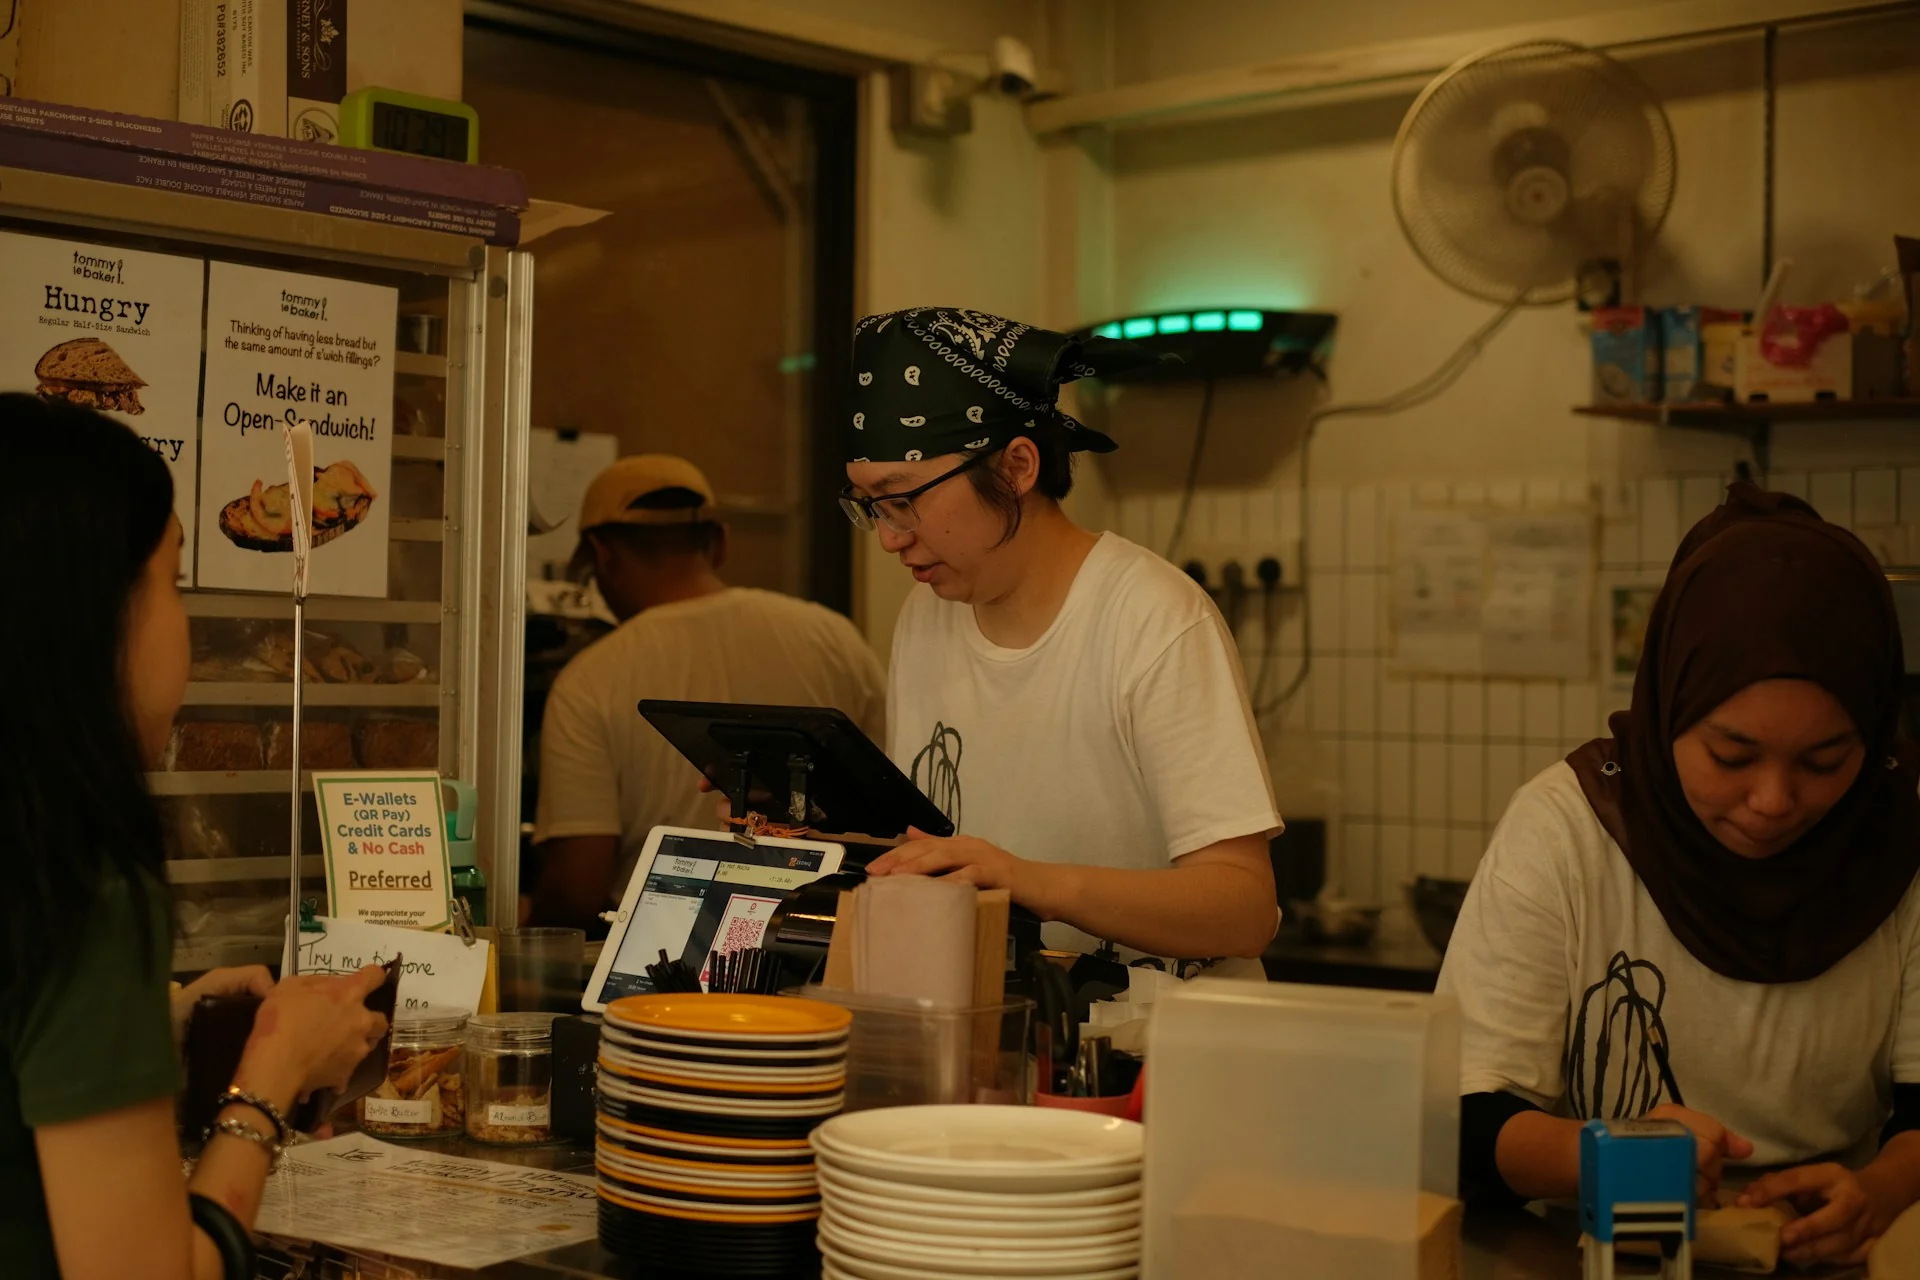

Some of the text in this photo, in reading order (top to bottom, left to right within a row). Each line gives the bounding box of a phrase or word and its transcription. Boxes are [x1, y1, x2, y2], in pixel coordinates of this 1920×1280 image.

[301, 32, 311, 42] &
[301, 46, 311, 79] SONS
[15, 116, 45, 126] SHEETS
[39, 109, 87, 123] PARCHMENT
[88, 117, 113, 127] 2-SIDE
[115, 121, 162, 134] SILICONIZED
[138, 155, 165, 166] FRANCE
[136, 175, 153, 185] FACE
[155, 178, 182, 189] DOUBLE
[256, 173, 274, 182] AVEC
[283, 198, 305, 208] PAPIER
[329, 204, 370, 218] SILICONIZED
[428, 211, 451, 220] SHEETS
[392, 215, 431, 227] PARCHMENT
[432, 221, 467, 233] VEGETABLE
[73, 251, 115, 272] tommy
[44, 285, 150, 325] Hungry
[281, 289, 320, 308] tommy
[39, 316, 151, 336] Regular Half-Size Sandwich
[230, 320, 376, 350] Thinking of having less bread but
[225, 336, 380, 370] the same amount of s'wich fillings?
[257, 373, 347, 406] Make it an
[343, 792, 417, 805] E-Wallets
[354, 809, 410, 822] (QR Pay)
[337, 824, 431, 837] Credit Cards
[348, 841, 425, 855] & No Cash
[349, 870, 432, 889] Preferred
[370, 908, 408, 920] appreciate
[409, 910, 426, 921] your
[342, 955, 362, 969] me
